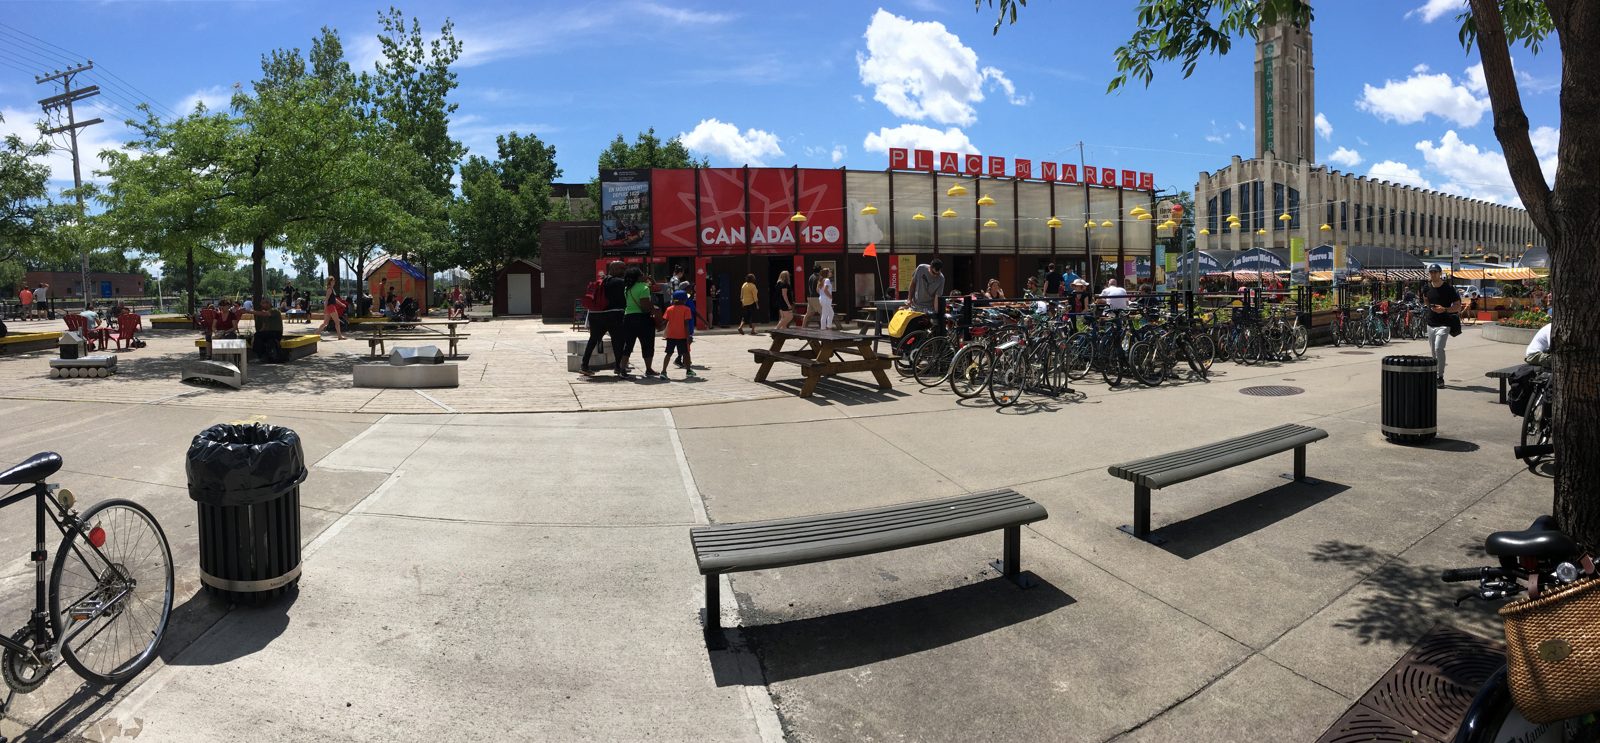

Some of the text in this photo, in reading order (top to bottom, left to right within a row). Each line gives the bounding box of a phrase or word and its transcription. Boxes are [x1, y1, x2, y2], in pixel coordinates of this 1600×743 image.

[1265, 65, 1274, 151] ATWATER
[891, 150, 1003, 174] PLACE
[1017, 162, 1030, 174] DU
[701, 225, 840, 245] CANADA 150
